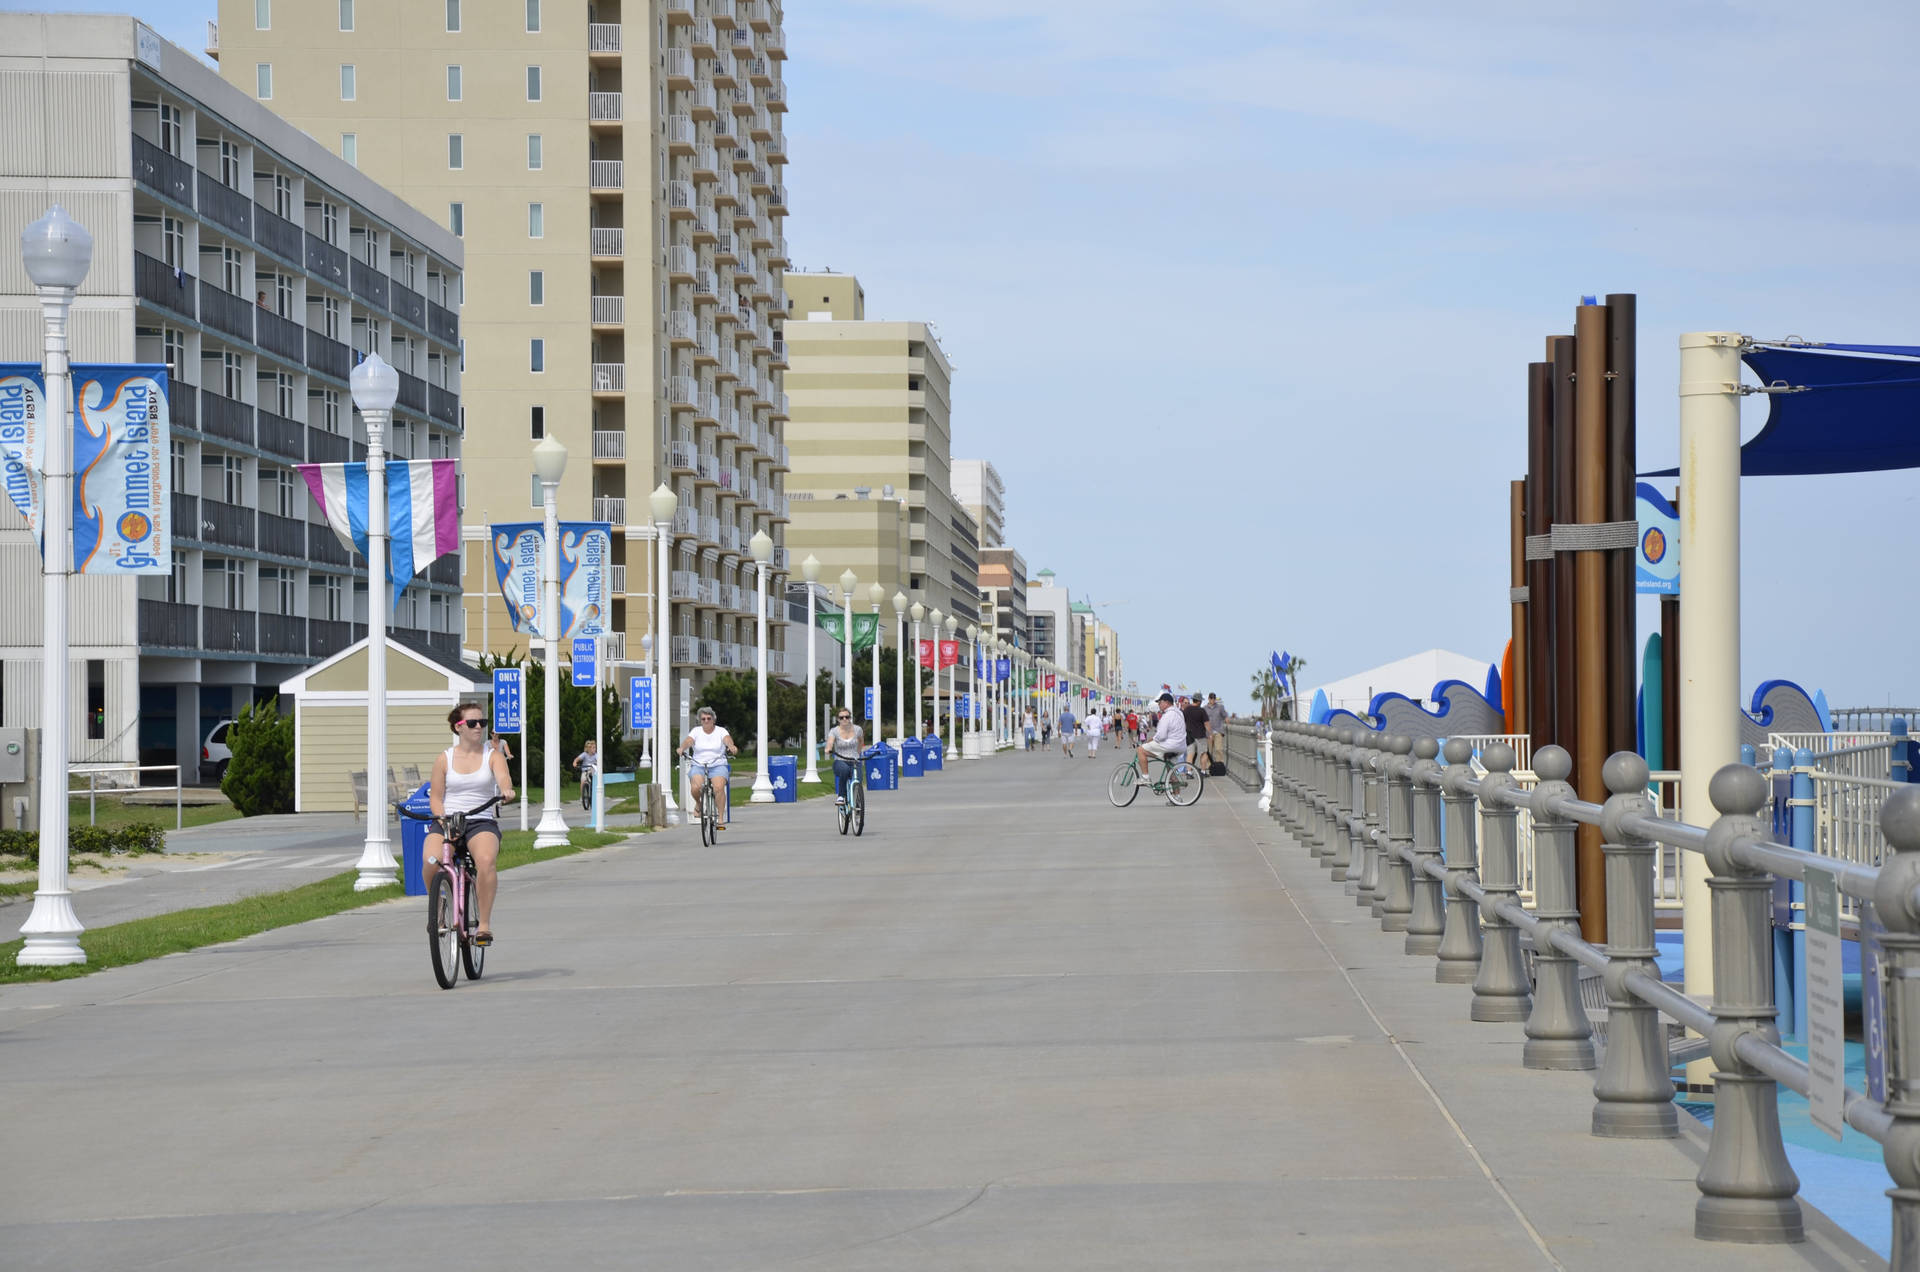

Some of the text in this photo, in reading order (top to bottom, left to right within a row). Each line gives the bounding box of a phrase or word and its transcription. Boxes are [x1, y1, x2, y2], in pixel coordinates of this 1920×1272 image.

[0, 384, 25, 444] Island
[117, 384, 149, 445] Island
[517, 535, 535, 568] Island
[582, 535, 600, 568] Island
[575, 643, 593, 651] PUBLIC
[499, 672, 518, 682] ONLY
[635, 680, 650, 688] ONLY
